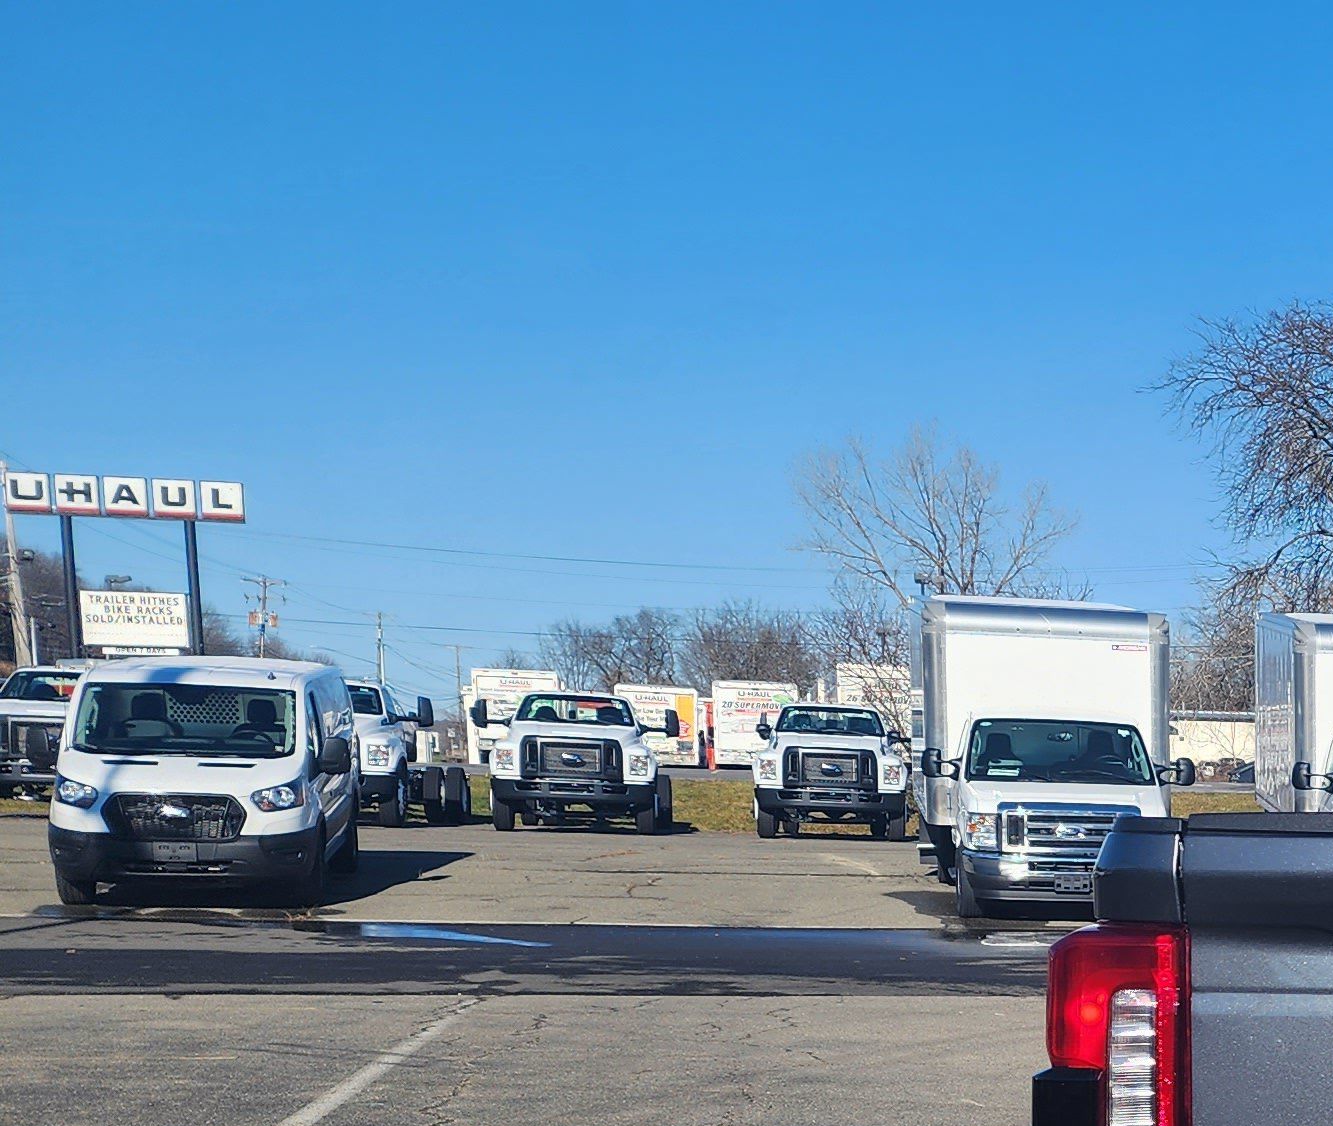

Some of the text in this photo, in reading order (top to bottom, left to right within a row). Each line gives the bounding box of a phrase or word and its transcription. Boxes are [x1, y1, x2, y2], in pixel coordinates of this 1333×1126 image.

[88, 594, 135, 605] TRAILER
[104, 605, 173, 616] BIKE RACKS
[86, 614, 183, 626] SOLD/INSTALLED
